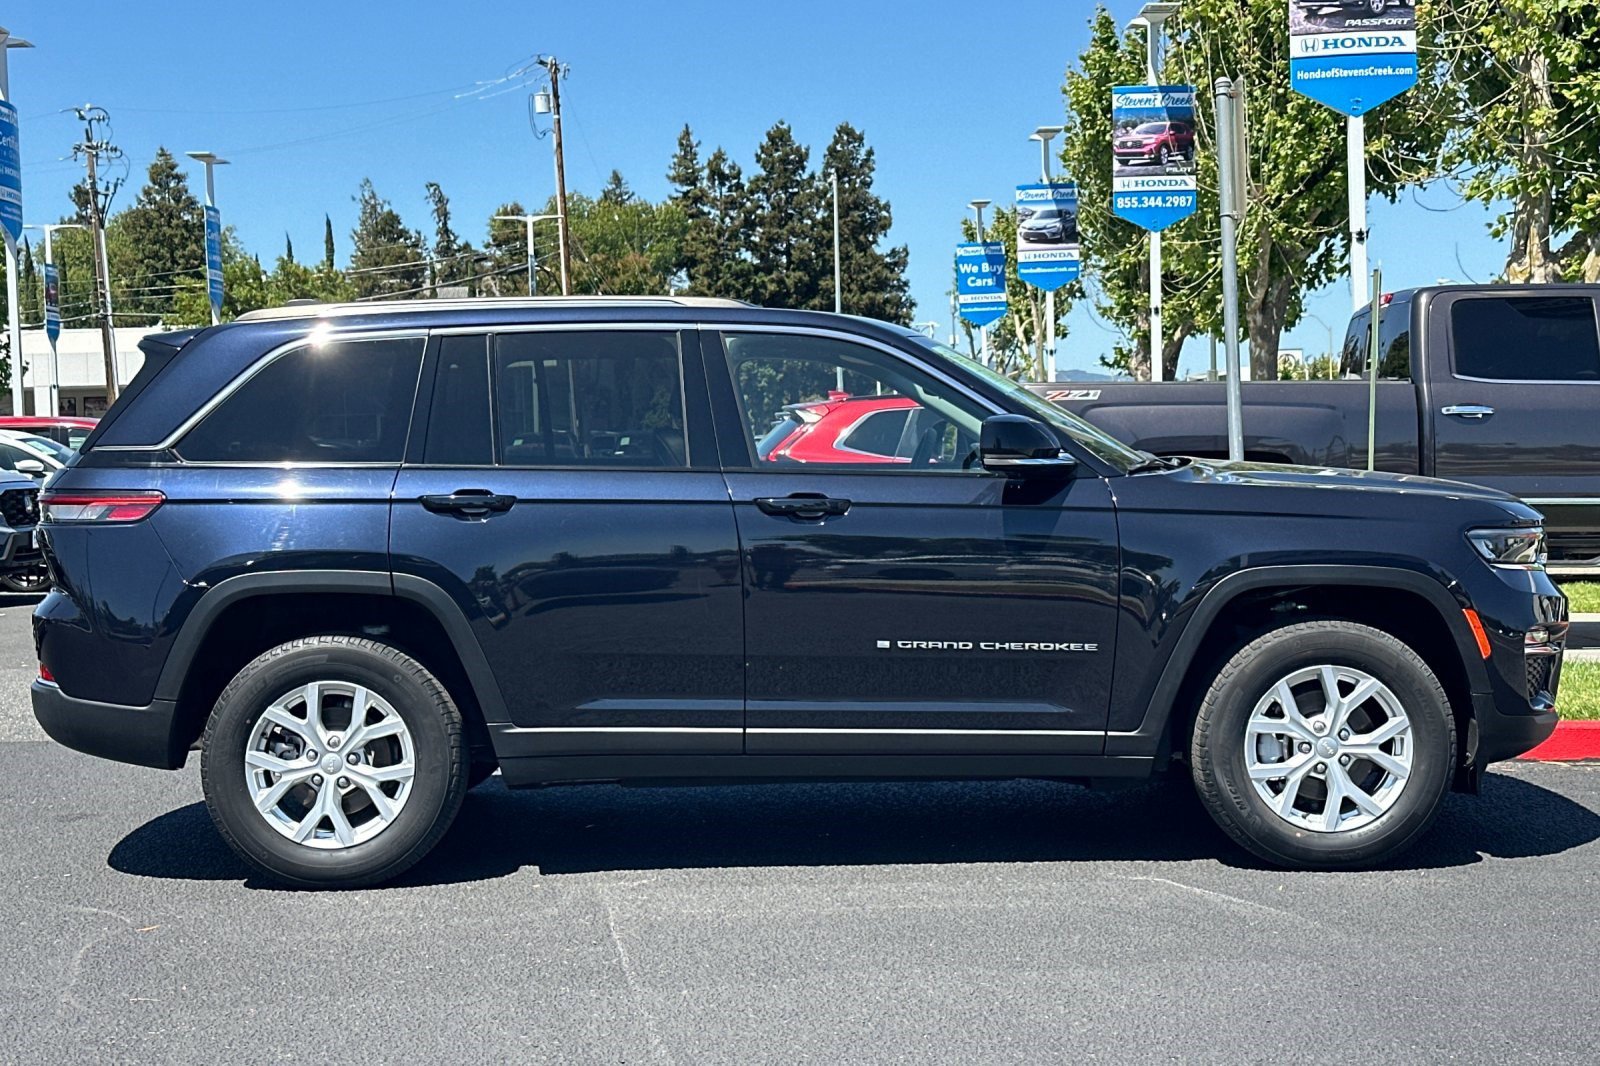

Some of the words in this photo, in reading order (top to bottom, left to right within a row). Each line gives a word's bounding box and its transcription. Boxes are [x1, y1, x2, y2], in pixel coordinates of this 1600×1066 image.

[1344, 17, 1411, 27] PASSPORT
[1321, 36, 1407, 50] HONDA
[1296, 65, 1413, 80] HondaofStevensCreek.com
[1160, 92, 1194, 107] Creek
[1133, 179, 1190, 188] HONDA
[1116, 195, 1193, 209] 855.344.2987
[1033, 252, 1074, 260] HONDA
[959, 263, 979, 274] We
[981, 262, 1003, 275] Buy
[967, 276, 996, 287] Cars!
[1045, 389, 1102, 402] Z71
[897, 640, 973, 650] GRAND
[979, 641, 1099, 651] CHEROKEE
